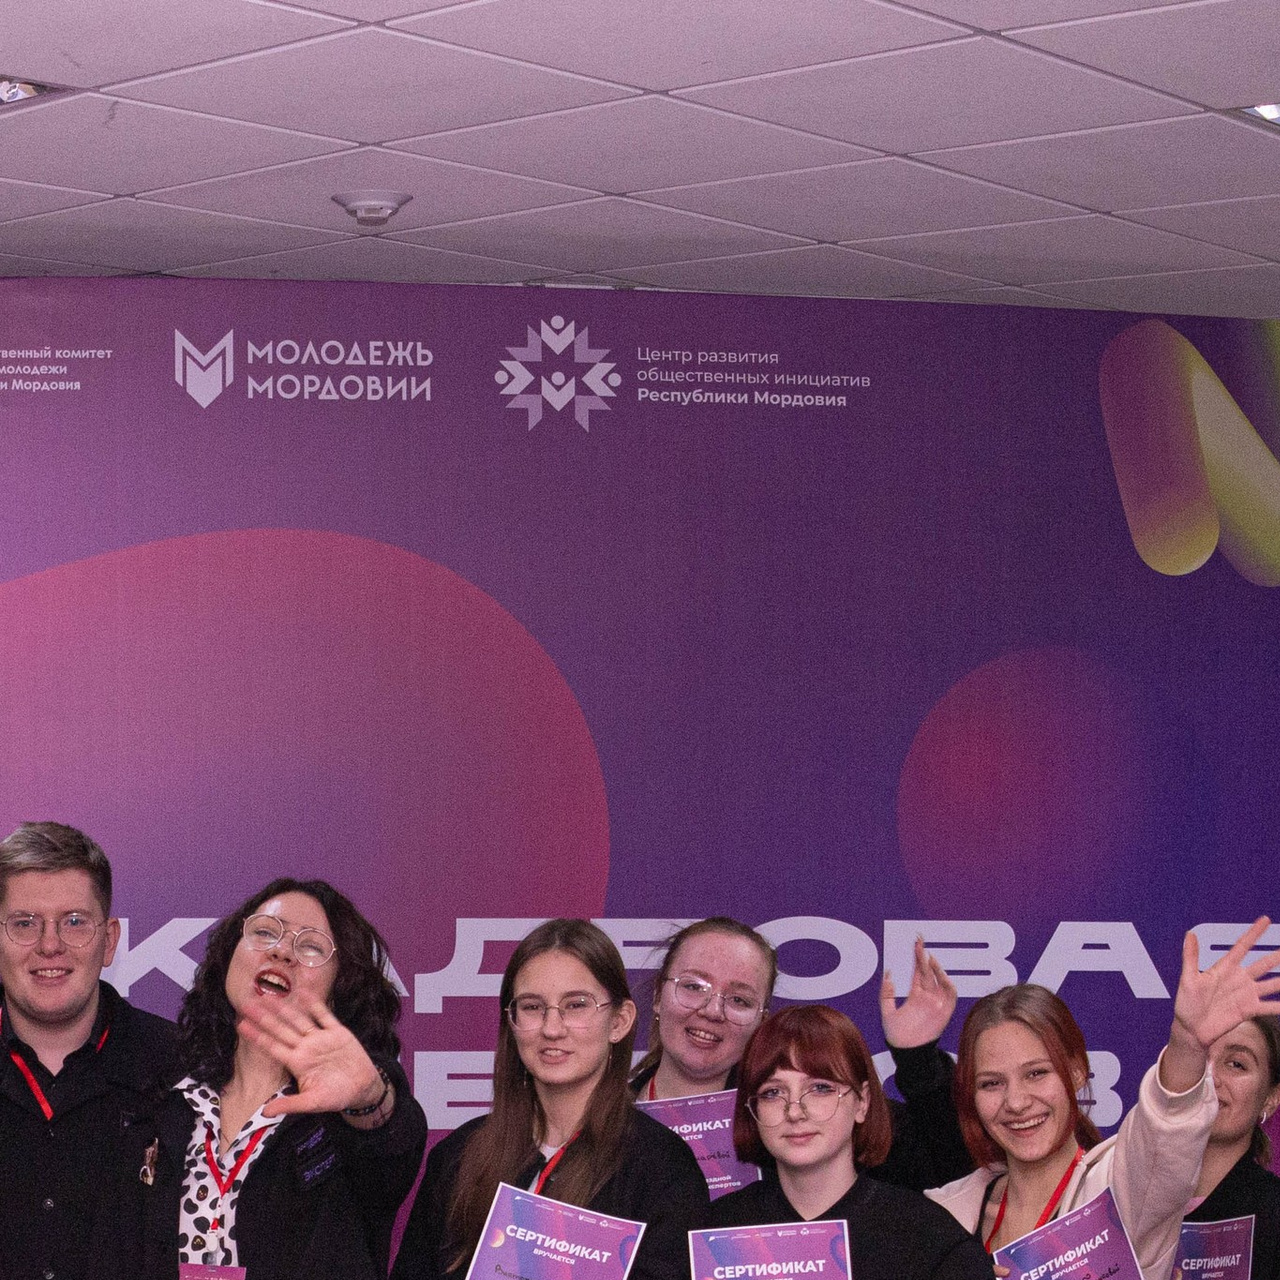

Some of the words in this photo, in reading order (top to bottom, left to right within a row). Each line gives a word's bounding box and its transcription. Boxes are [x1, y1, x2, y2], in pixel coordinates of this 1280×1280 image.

[55, 349, 112, 359] комитет
[247, 339, 433, 366] МОЛОДЕЖЬ
[637, 347, 692, 364] Центр
[697, 350, 779, 365] развития
[11, 379, 81, 392] Мордовия
[637, 367, 770, 386] общественных
[774, 372, 871, 388] инициатив
[247, 374, 431, 401] МОРДОВИИ
[637, 388, 749, 406] Республики
[753, 391, 847, 408] Мордовия
[669, 1119, 731, 1134] ИФИКАТ
[506, 1225, 611, 1262] СЕРТИФИКАТ
[533, 1248, 575, 1265] ВРУЧАЕТСЯ
[1182, 1254, 1241, 1270] СЕРТИФИКАТ
[714, 1260, 825, 1279] СЕРТИФИКАТ
[1051, 1258, 1088, 1280] ВРУЧАЕТСЯ
